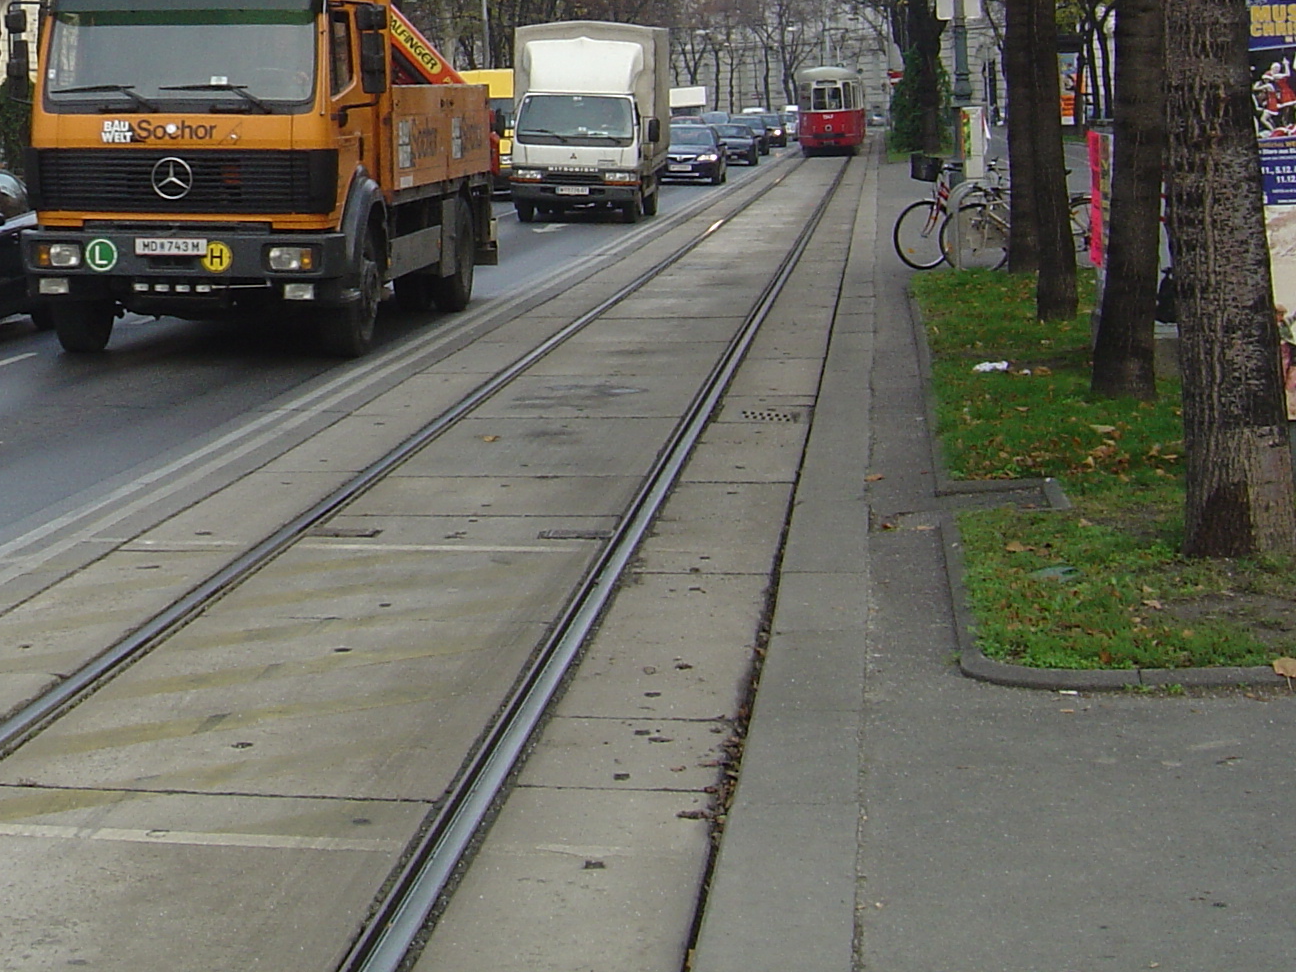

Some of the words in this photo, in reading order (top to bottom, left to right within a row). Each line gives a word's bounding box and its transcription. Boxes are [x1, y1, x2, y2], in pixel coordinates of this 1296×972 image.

[390, 16, 438, 70] ALFINGER
[104, 120, 130, 132] BAU
[137, 119, 217, 140] Sochor
[101, 132, 133, 143] WELT
[95, 245, 109, 265] L
[210, 248, 223, 266] H
